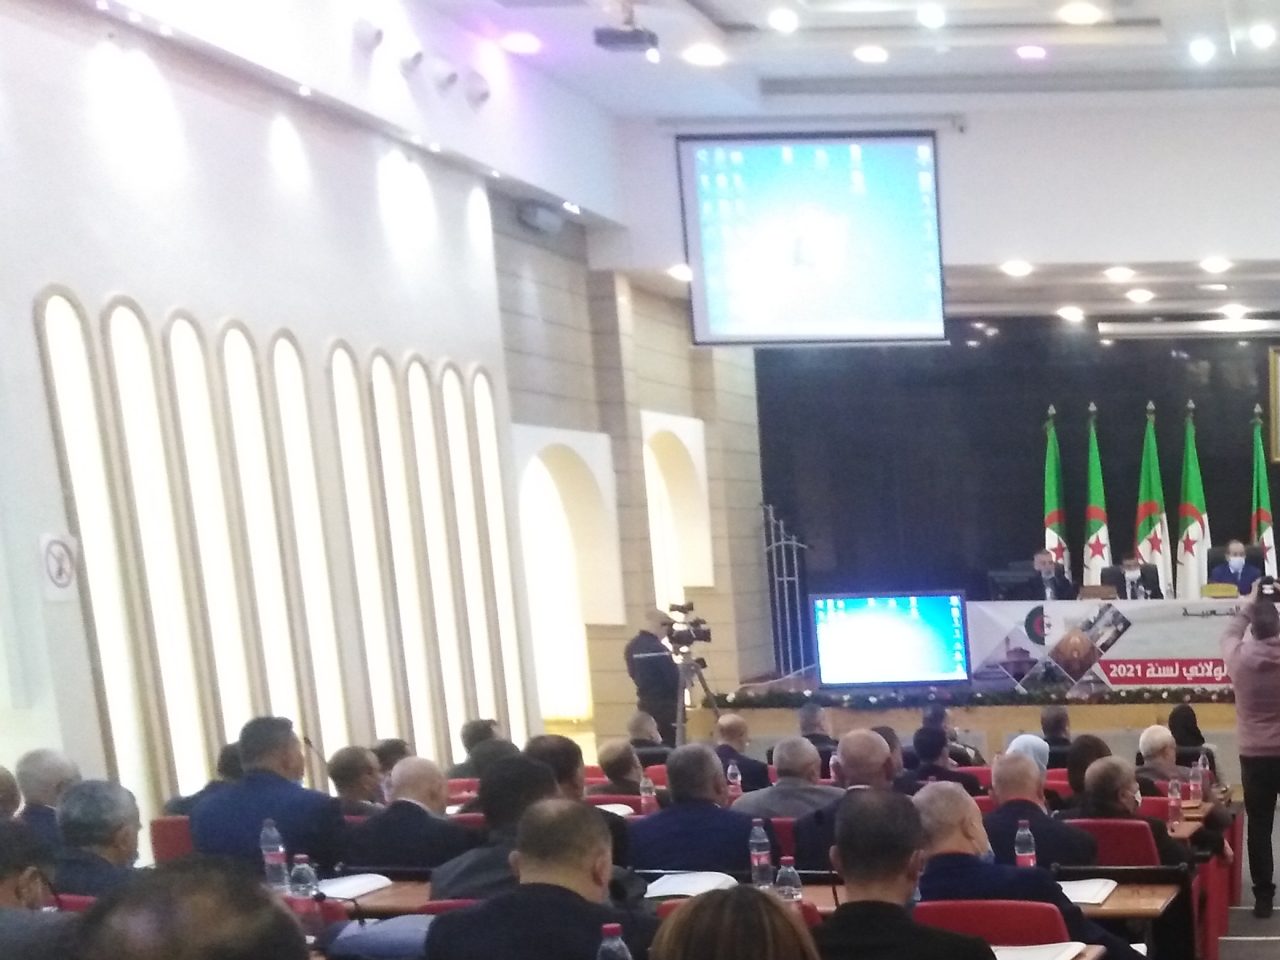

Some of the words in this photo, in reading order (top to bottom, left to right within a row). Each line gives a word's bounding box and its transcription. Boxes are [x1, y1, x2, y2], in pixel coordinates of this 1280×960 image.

[1109, 663, 1142, 677] 2021
[1146, 661, 1179, 678] لسنة
[1182, 661, 1228, 682] لولائي
